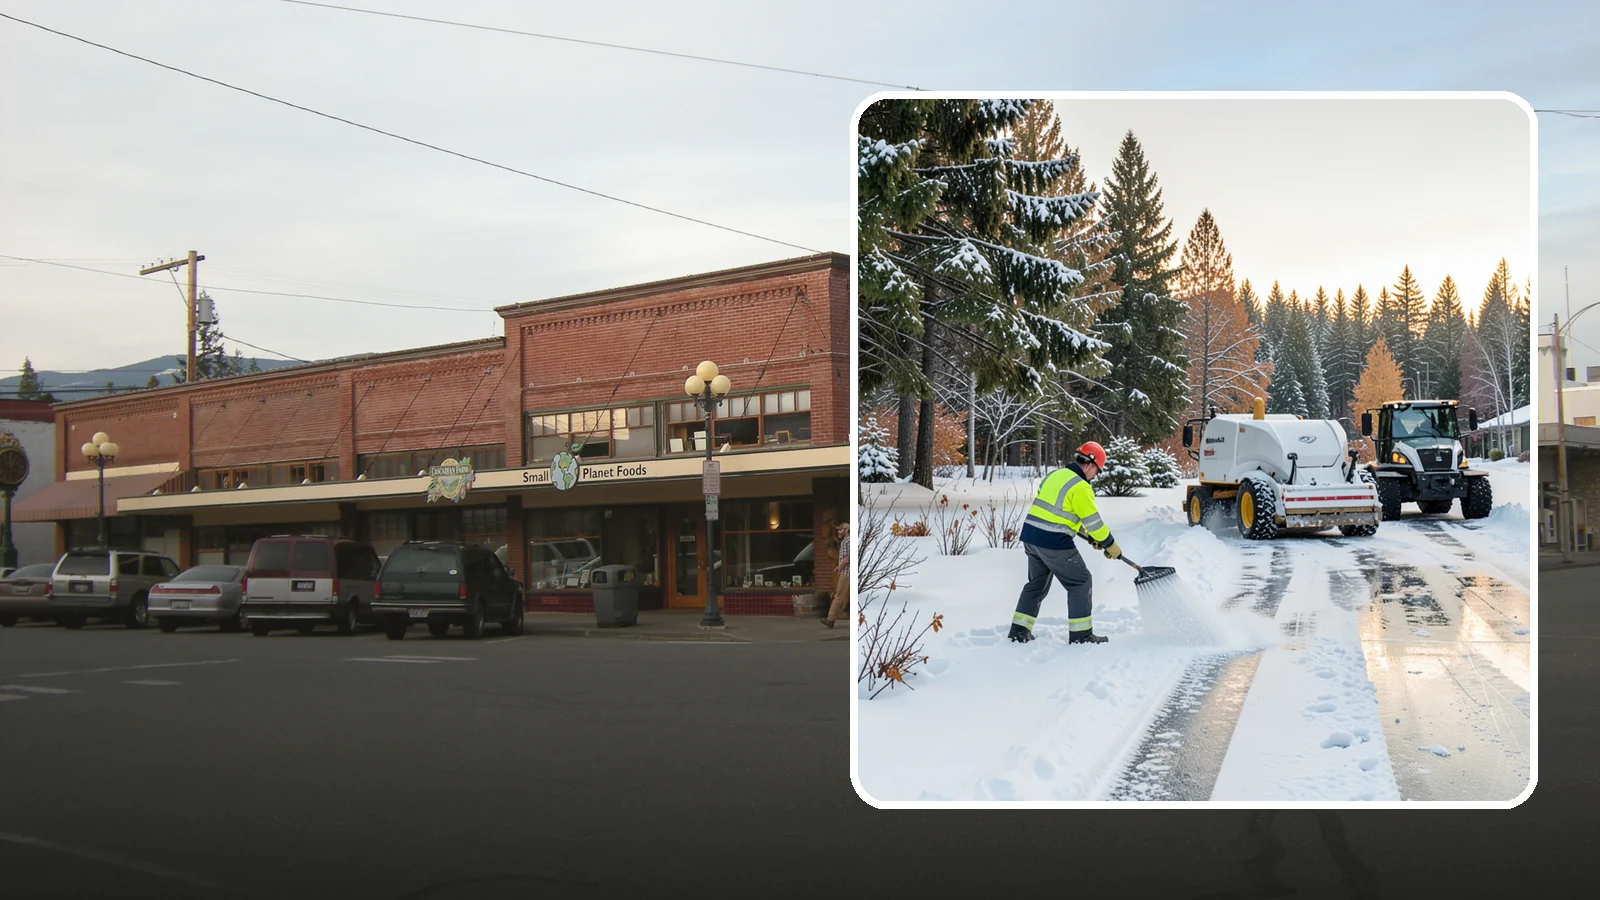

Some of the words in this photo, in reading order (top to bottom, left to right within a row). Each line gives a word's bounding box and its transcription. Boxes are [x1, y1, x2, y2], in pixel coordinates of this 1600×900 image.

[523, 471, 549, 482] Small
[582, 467, 614, 479] Planet
[616, 464, 647, 477] Foods
